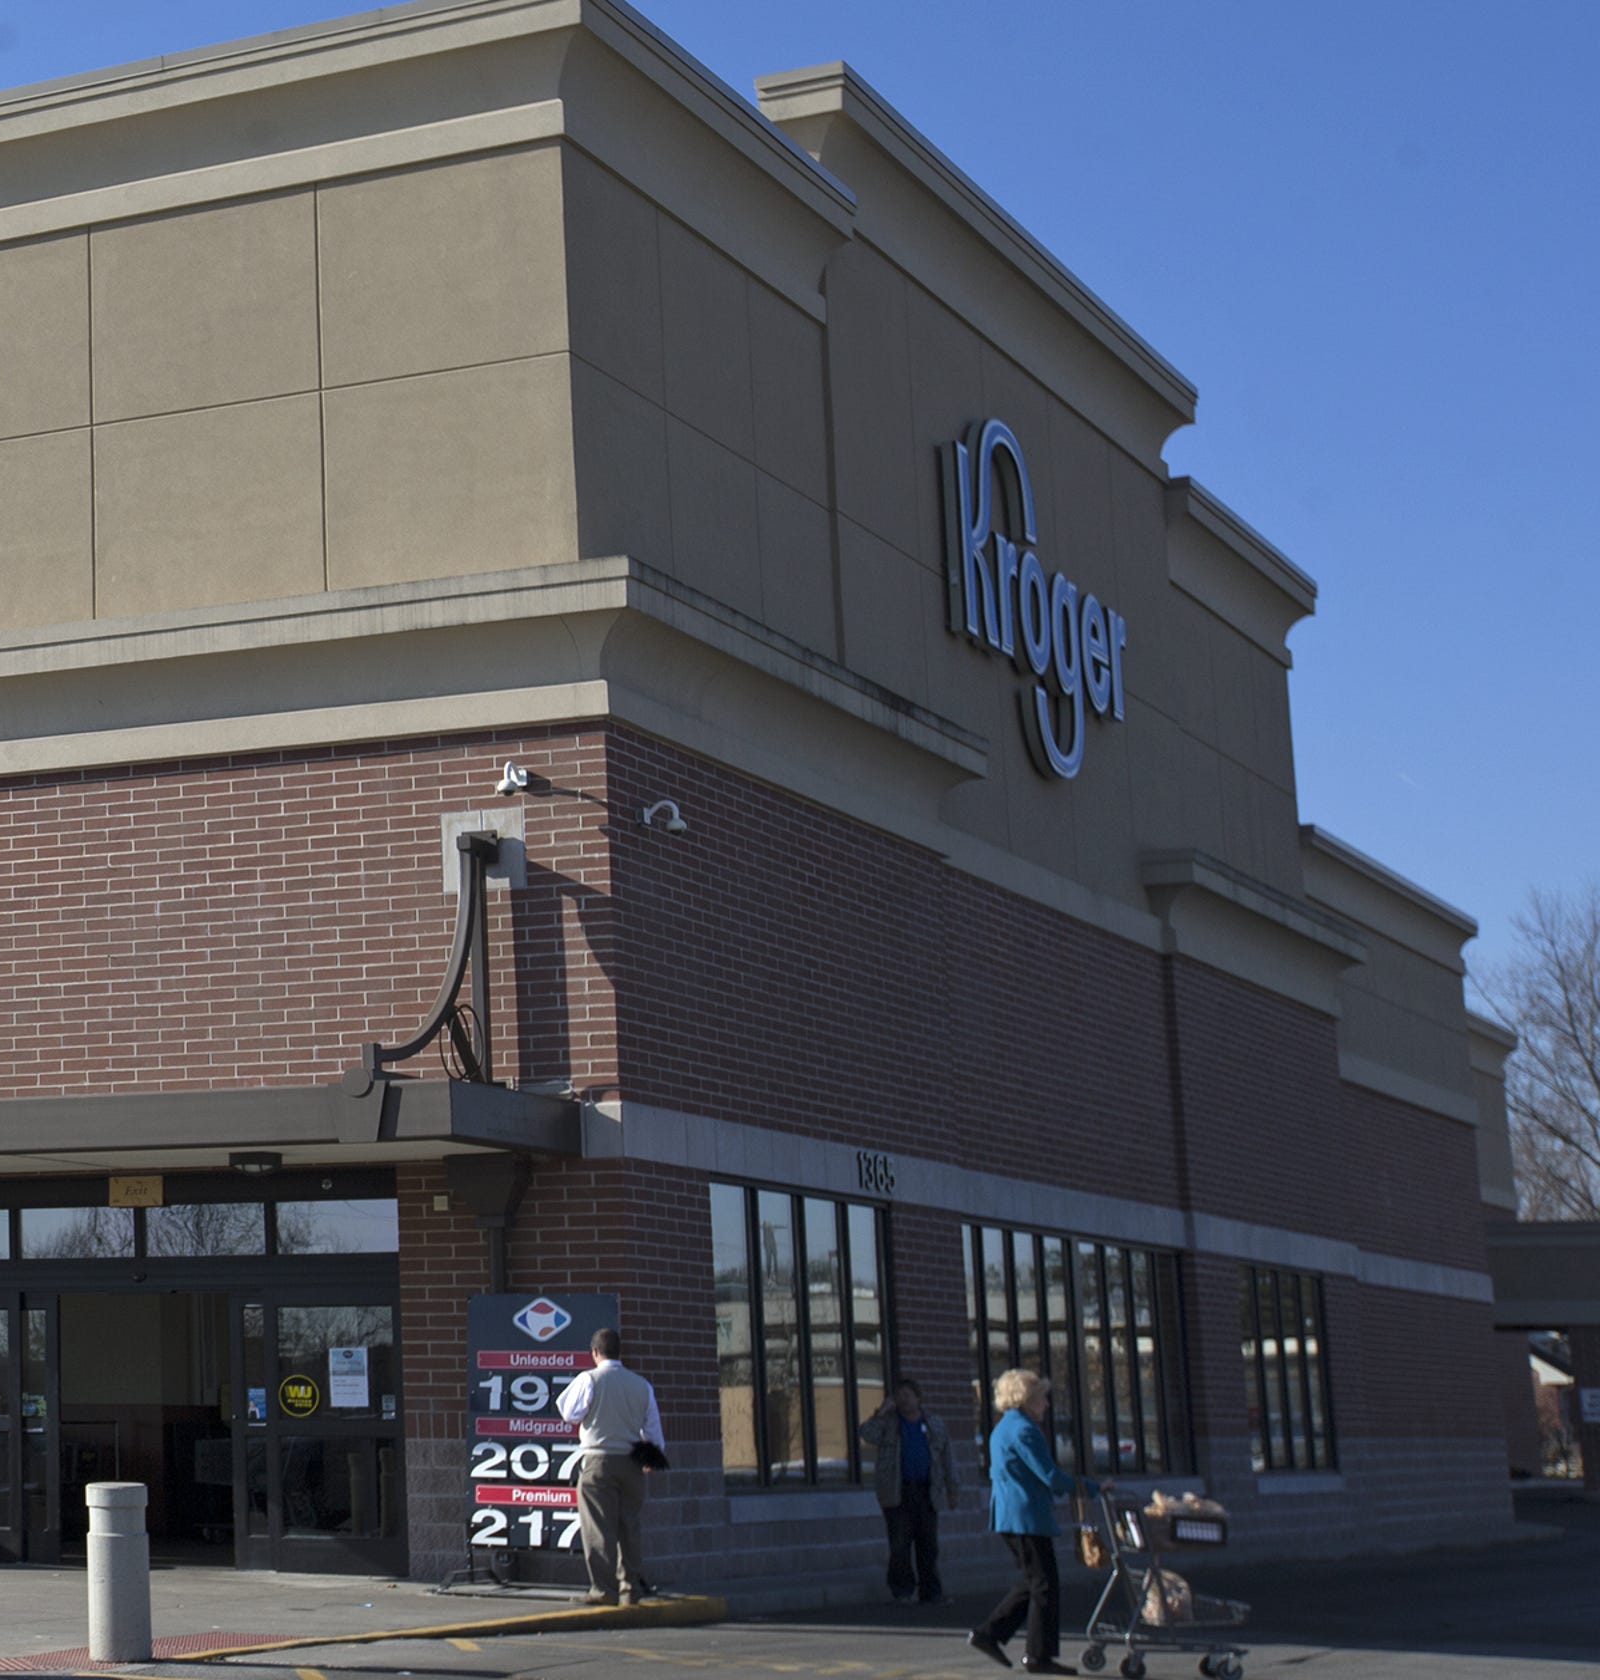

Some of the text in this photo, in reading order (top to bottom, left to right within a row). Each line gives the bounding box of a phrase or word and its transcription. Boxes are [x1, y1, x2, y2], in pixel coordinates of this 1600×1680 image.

[950, 418, 1127, 779] Kroger
[856, 1151, 895, 1193] 1365
[510, 1354, 574, 1366] Unleaded
[509, 1420, 573, 1434] Midgrade
[470, 1442, 586, 1480] 207
[512, 1489, 571, 1503] Premium
[470, 1508, 582, 1548] 217
